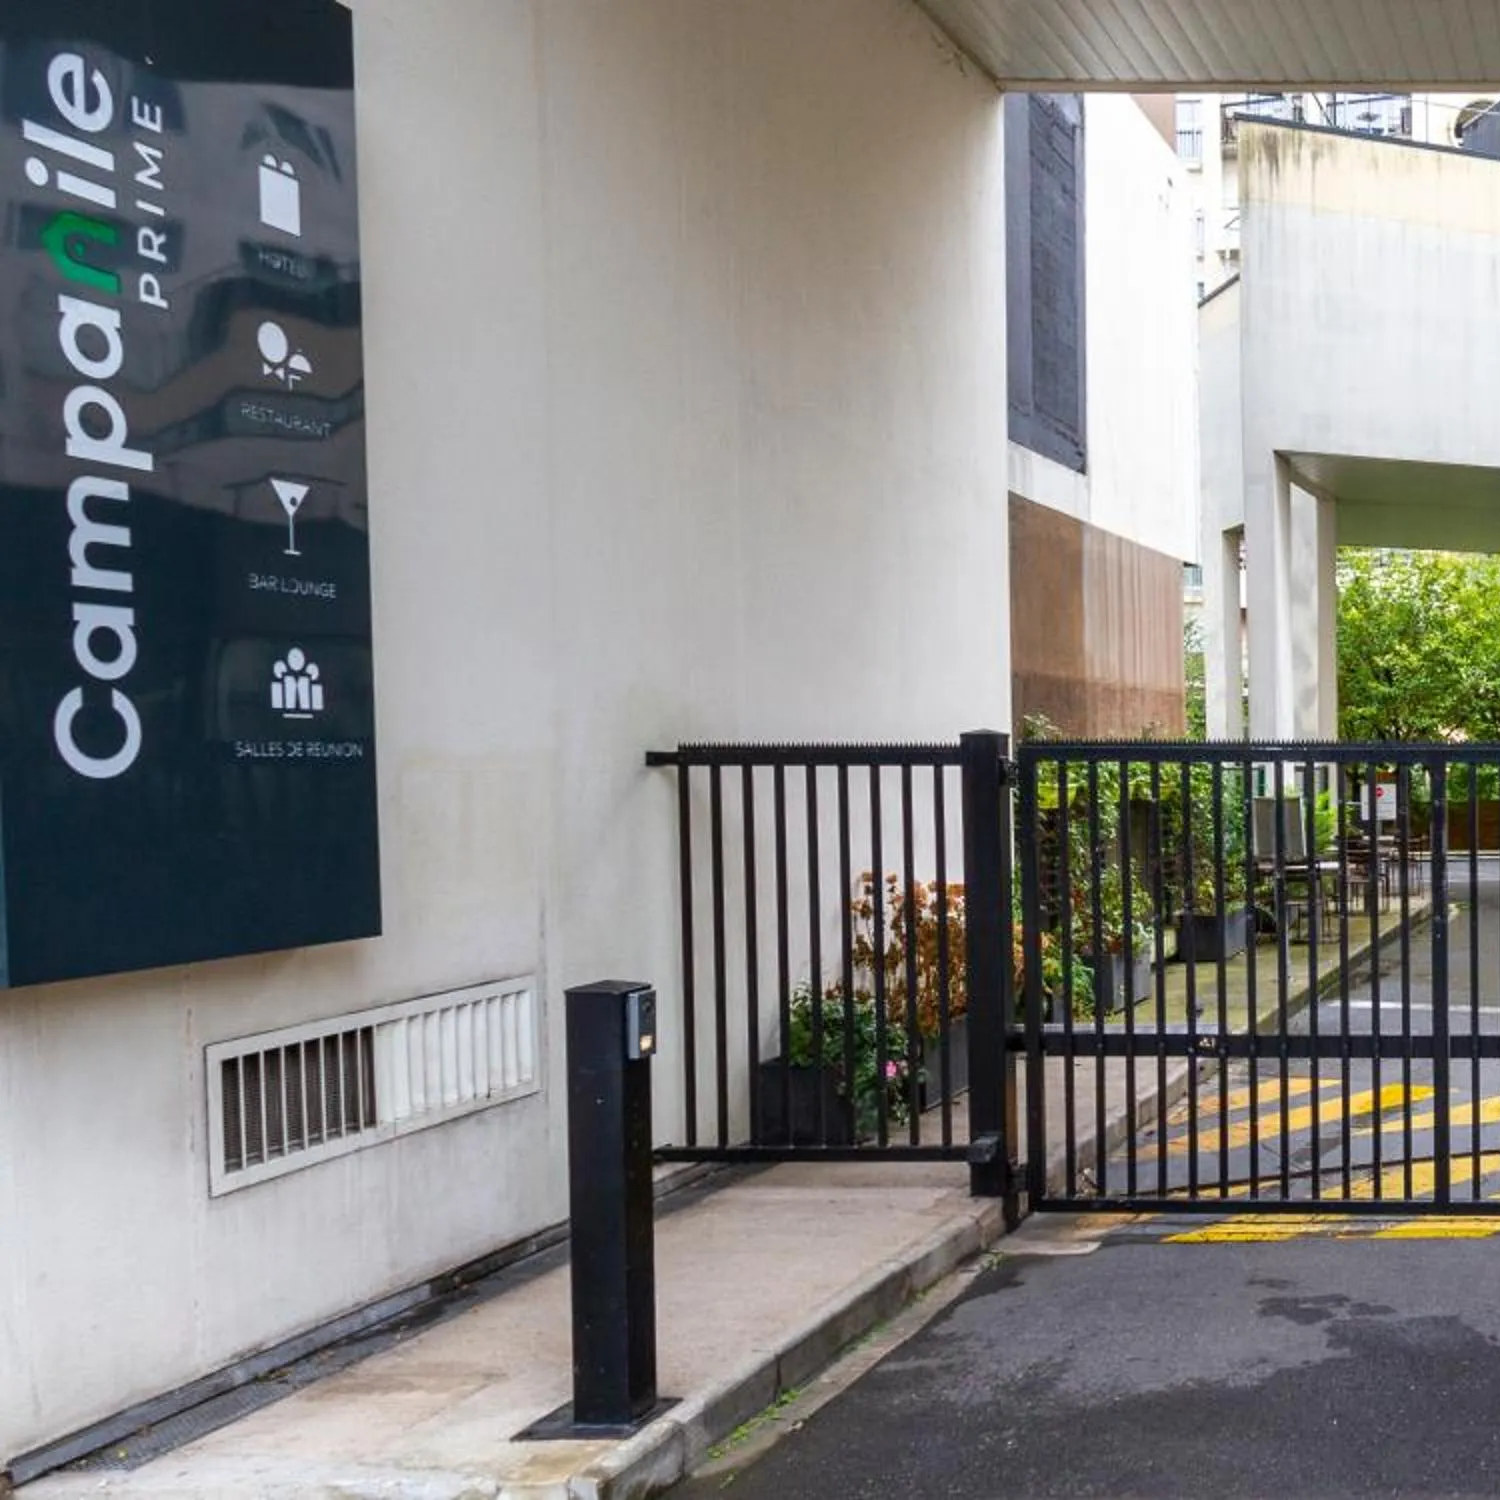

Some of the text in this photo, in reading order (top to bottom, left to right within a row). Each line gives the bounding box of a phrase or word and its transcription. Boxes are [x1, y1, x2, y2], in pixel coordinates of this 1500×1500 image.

[132, 96, 169, 310] PRIME
[23, 53, 153, 779] Campanile
[240, 401, 331, 438] RESTAURANT
[248, 573, 337, 598] BAR LOUNGE
[235, 741, 283, 757] SALLES
[286, 741, 303, 757] DE
